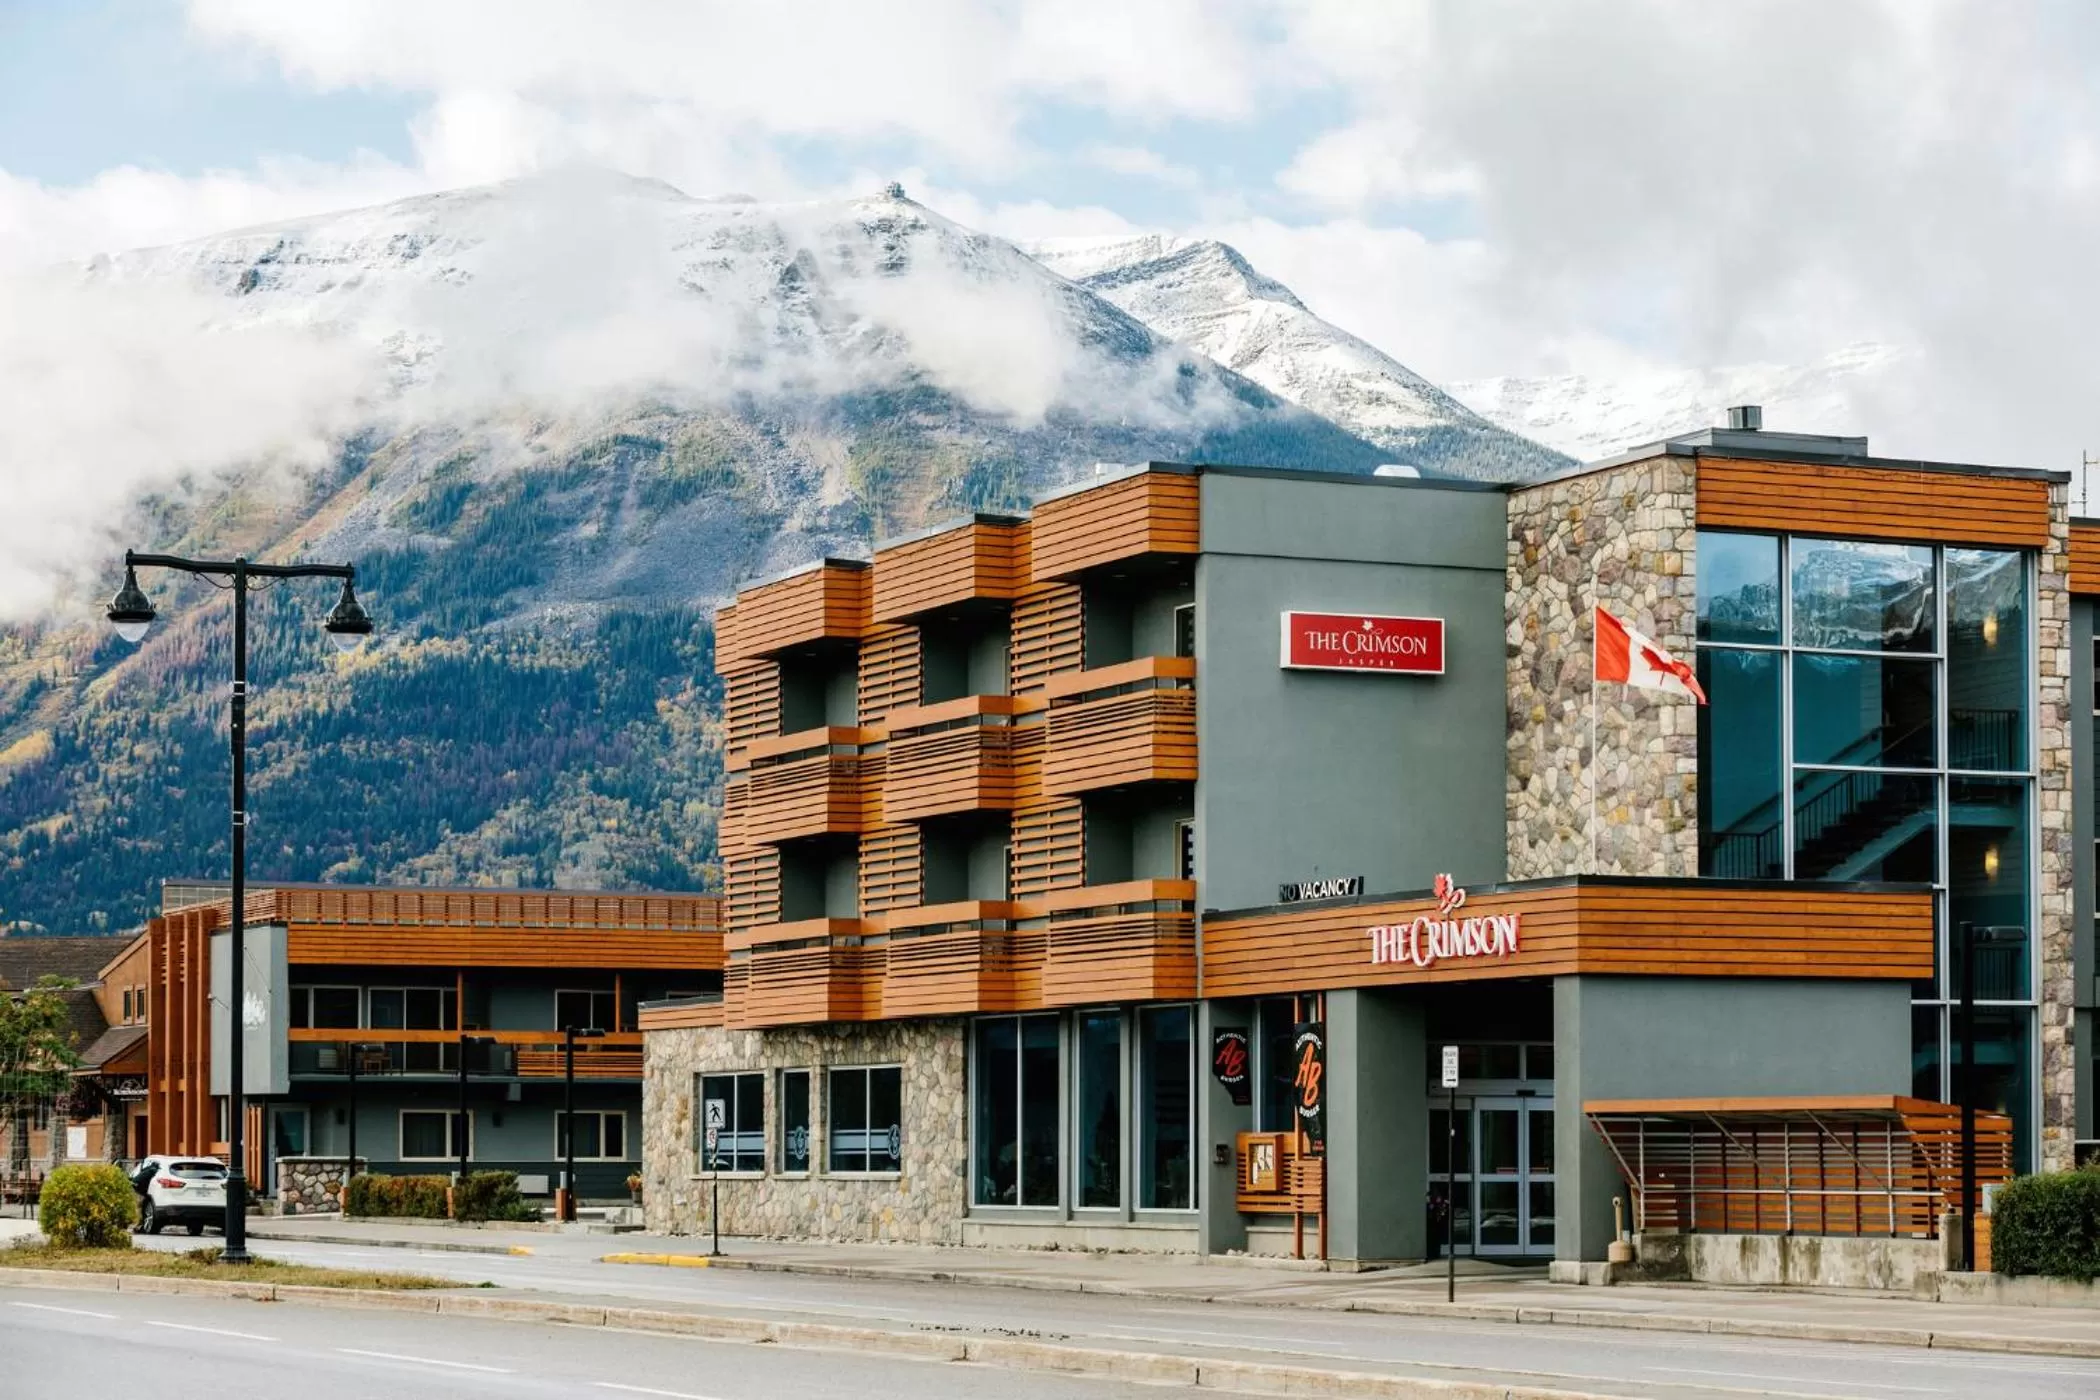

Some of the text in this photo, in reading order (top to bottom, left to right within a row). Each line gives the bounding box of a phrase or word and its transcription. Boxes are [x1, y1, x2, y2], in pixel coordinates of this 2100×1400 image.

[1304, 629, 1428, 656] THE CRIMSON
[1279, 877, 1352, 902] NO VACANCY
[1366, 913, 1519, 968] THE CRIMSON
